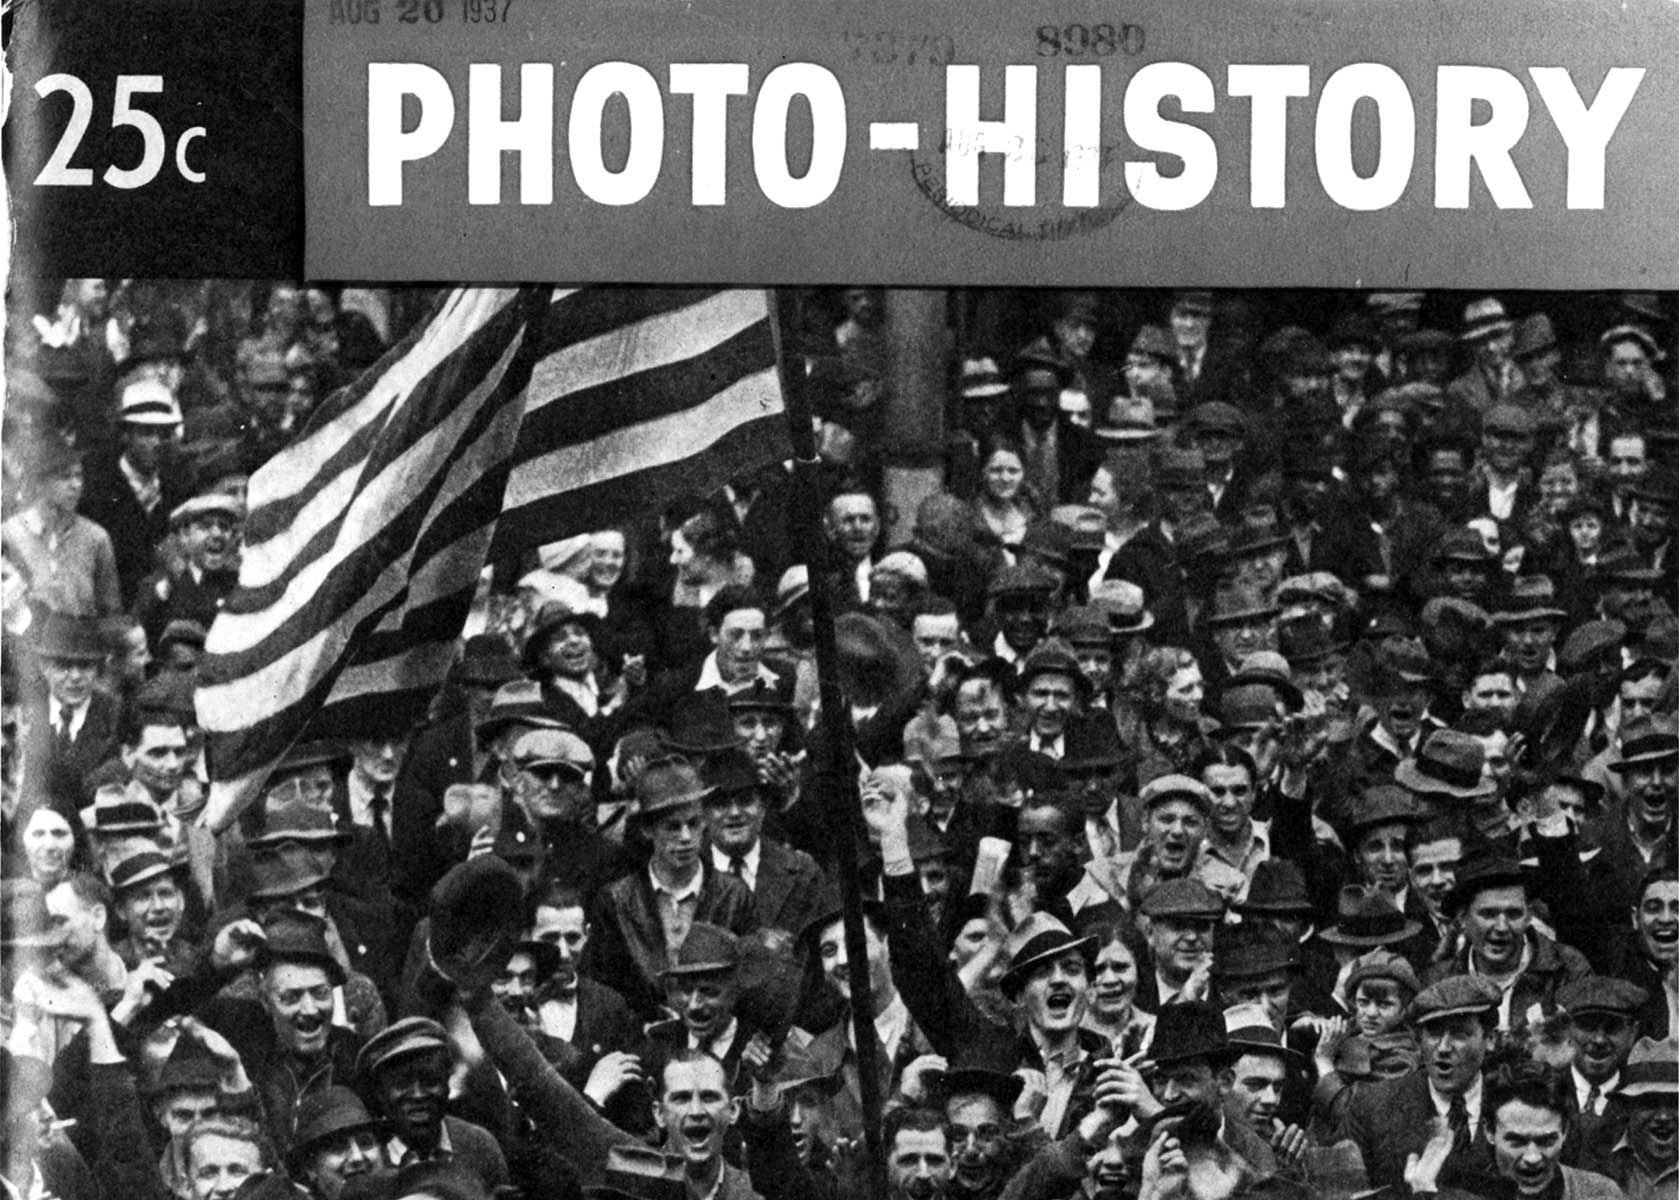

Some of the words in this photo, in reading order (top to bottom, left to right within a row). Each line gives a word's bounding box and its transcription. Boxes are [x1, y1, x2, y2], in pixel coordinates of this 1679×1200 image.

[396, 0, 444, 24] 20
[463, 0, 511, 23] 1937
[369, 62, 1646, 210] PHOTO-HISTORY
